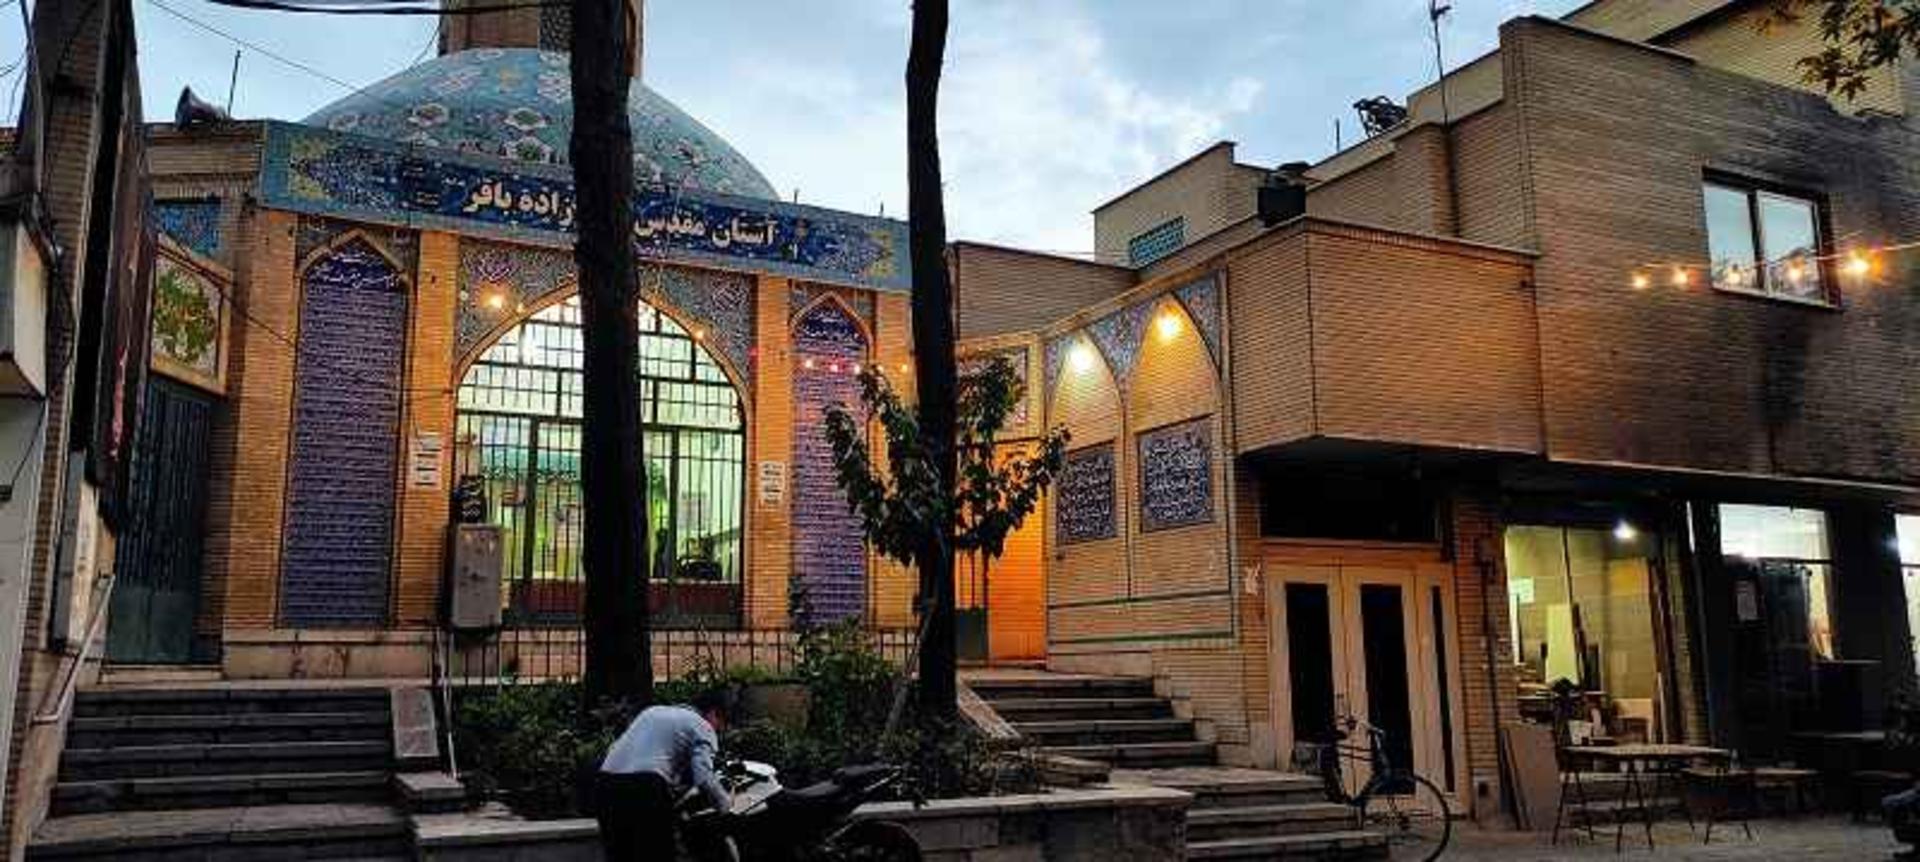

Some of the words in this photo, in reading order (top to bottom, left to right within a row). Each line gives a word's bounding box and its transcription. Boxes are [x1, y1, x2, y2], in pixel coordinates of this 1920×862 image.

[463, 178, 512, 217] باقر
[633, 210, 706, 237] مقدس
[712, 214, 778, 248] آستان
